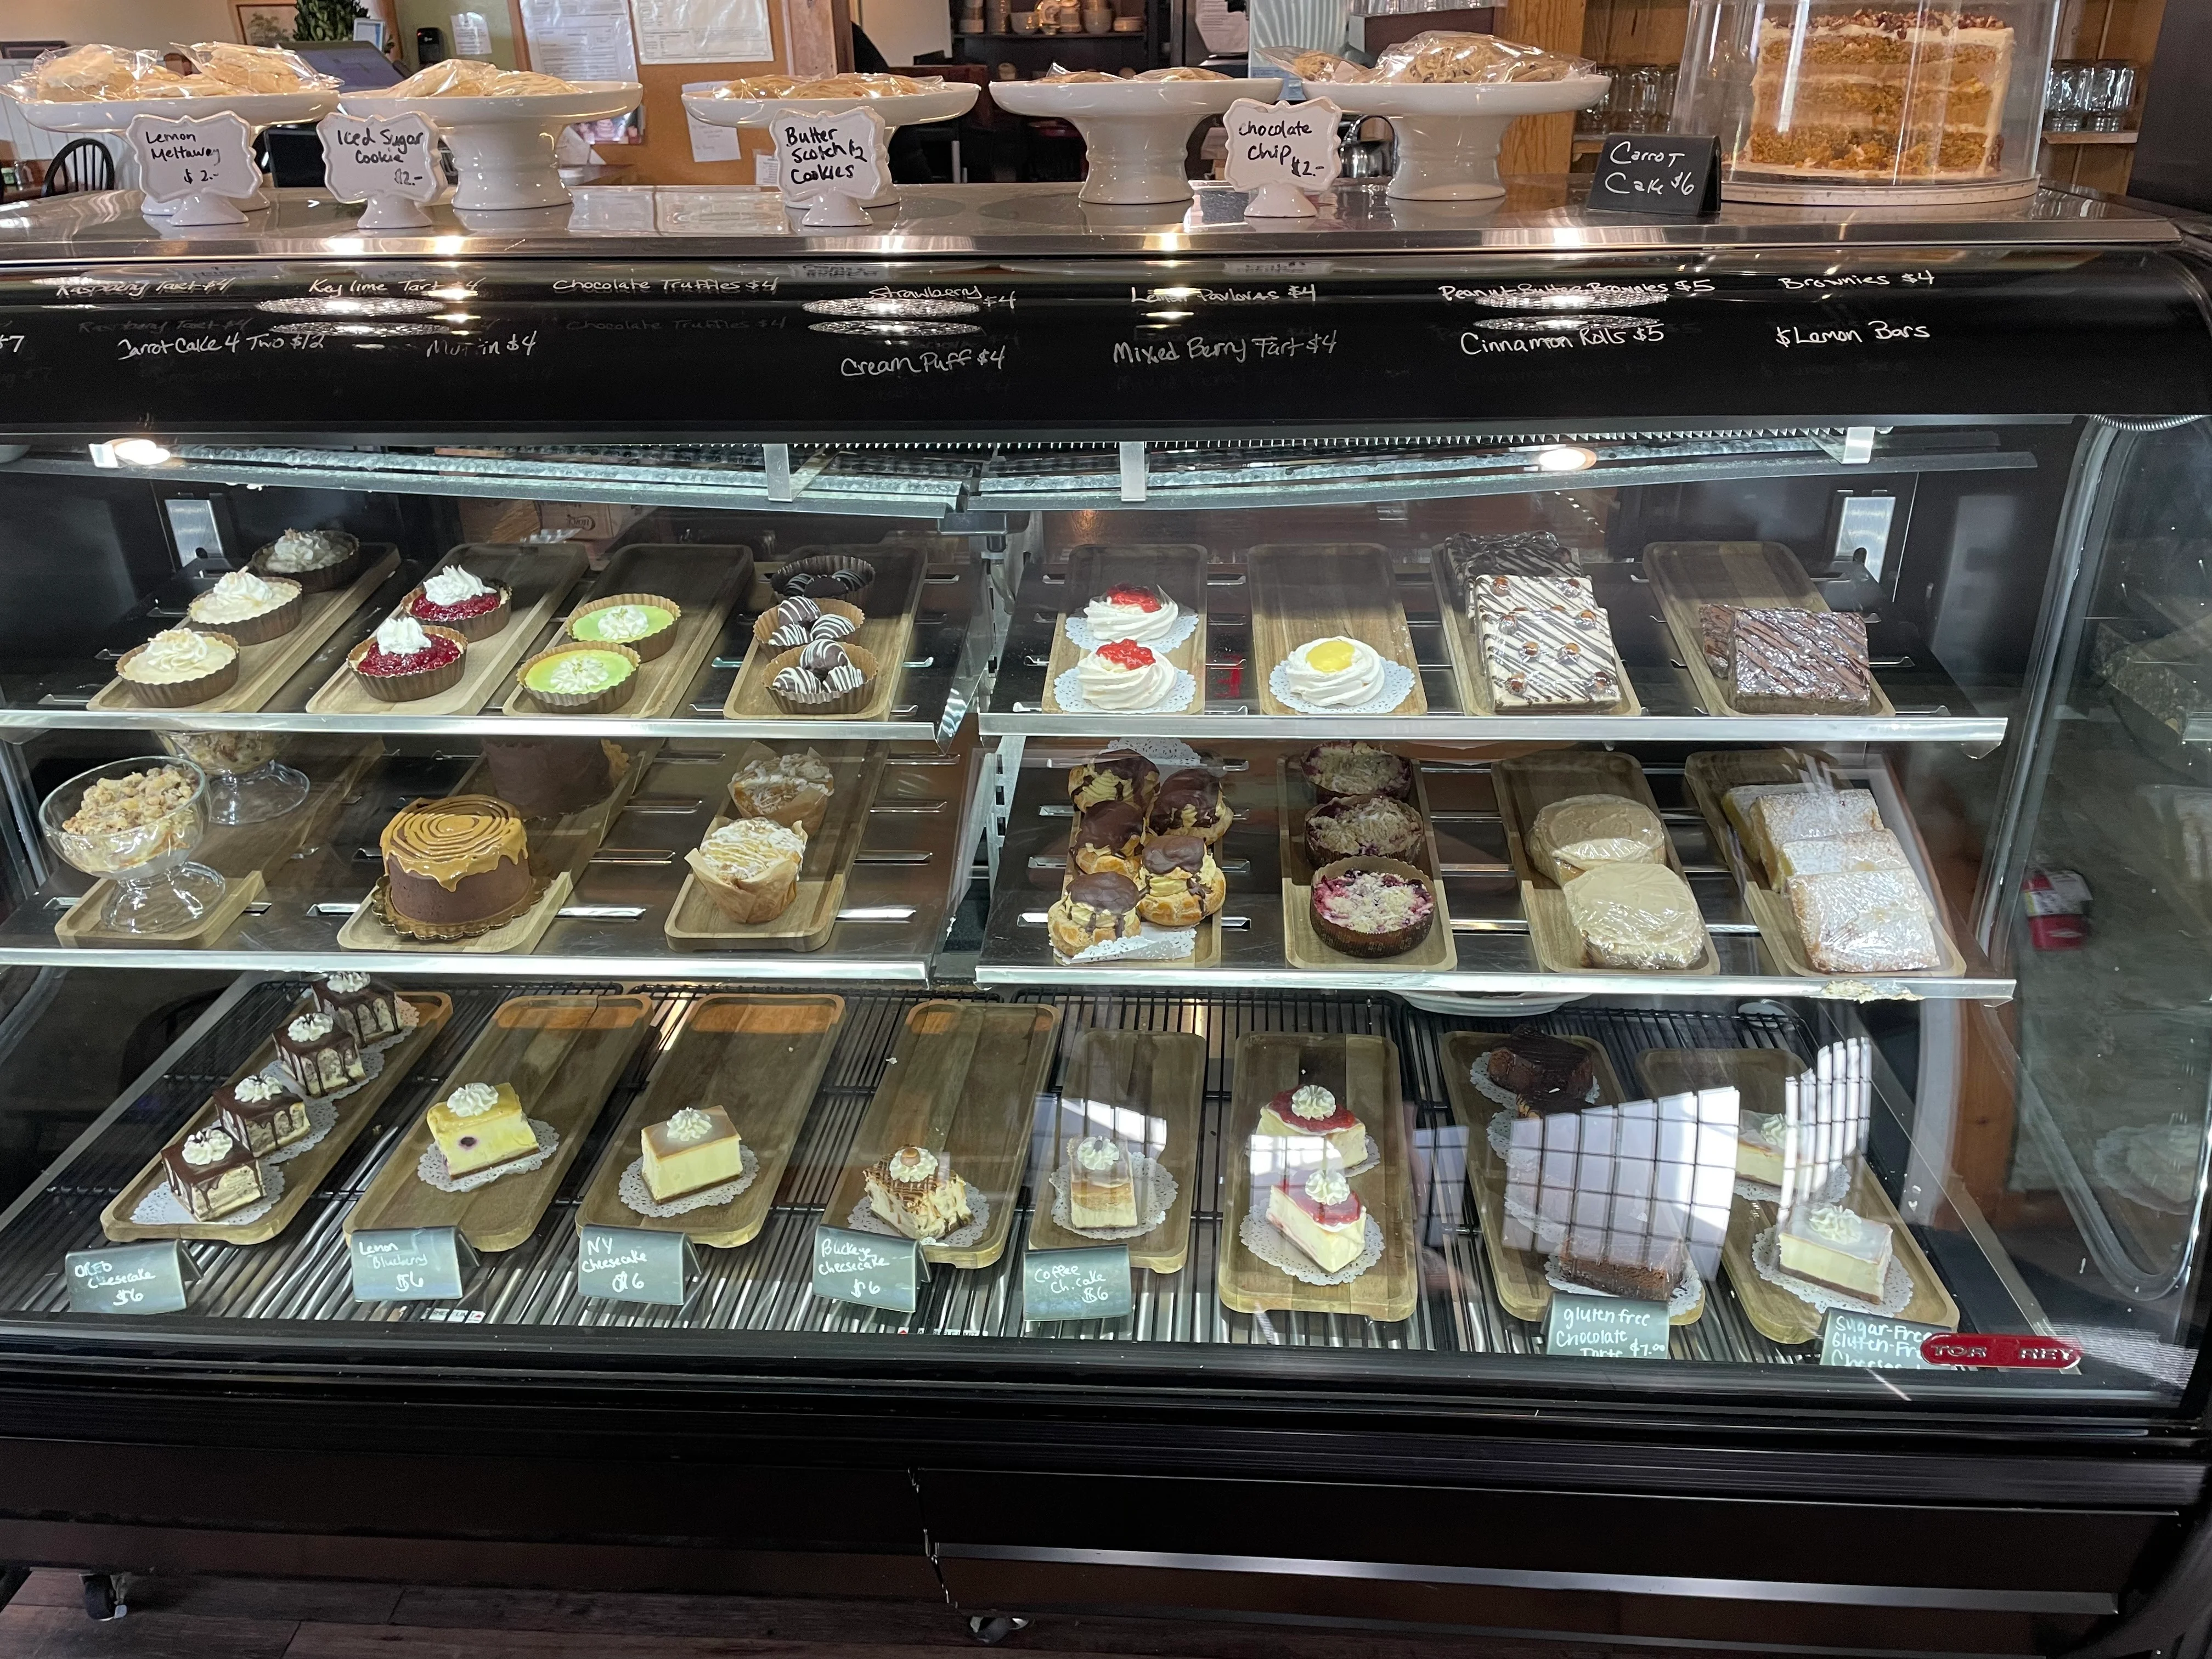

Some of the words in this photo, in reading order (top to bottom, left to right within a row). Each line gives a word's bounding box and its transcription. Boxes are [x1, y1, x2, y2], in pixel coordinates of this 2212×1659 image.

[145, 131, 196, 144] Lemon
[337, 127, 376, 146] Iced
[380, 129, 424, 155] Sugar
[785, 126, 838, 147] Butter
[355, 148, 404, 163] Cookie
[791, 164, 854, 184] Cookies
[1605, 172, 1664, 195] Cake
[1671, 172, 1695, 195] $6
[308, 278, 343, 298] Key
[397, 279, 444, 292] Tart
[552, 278, 651, 290] Chocolate
[660, 278, 741, 291] Truffles
[746, 276, 780, 291] $4
[1778, 275, 1890, 289] Brownies
[1901, 269, 1935, 285] $4
[868, 285, 983, 299] Strawberry
[983, 291, 1017, 309] $4
[1288, 284, 1316, 302] $4
[1438, 285, 1516, 301] Peanut
[1674, 279, 1716, 292] $5
[1460, 332, 1573, 355] Cinnamon
[1633, 323, 1664, 341] $5
[1867, 320, 1931, 340] Bars
[174, 335, 222, 354] Cake
[224, 331, 240, 353] 4
[246, 333, 284, 351] Two
[290, 333, 325, 349] $12
[426, 338, 500, 357] Muin
[506, 330, 537, 356] $4
[1113, 342, 1180, 364] Mixed
[1187, 336, 1246, 363] Berry
[1251, 336, 1304, 358] Tart
[1306, 330, 1337, 354] $4
[841, 357, 921, 376] Cream
[920, 349, 972, 373] Puff
[977, 345, 1006, 370] $4
[587, 1236, 613, 1256] NY
[1034, 1265, 1081, 1283] Coffee
[1564, 1306, 1615, 1330] gluten
[1618, 1308, 1651, 1327] free
